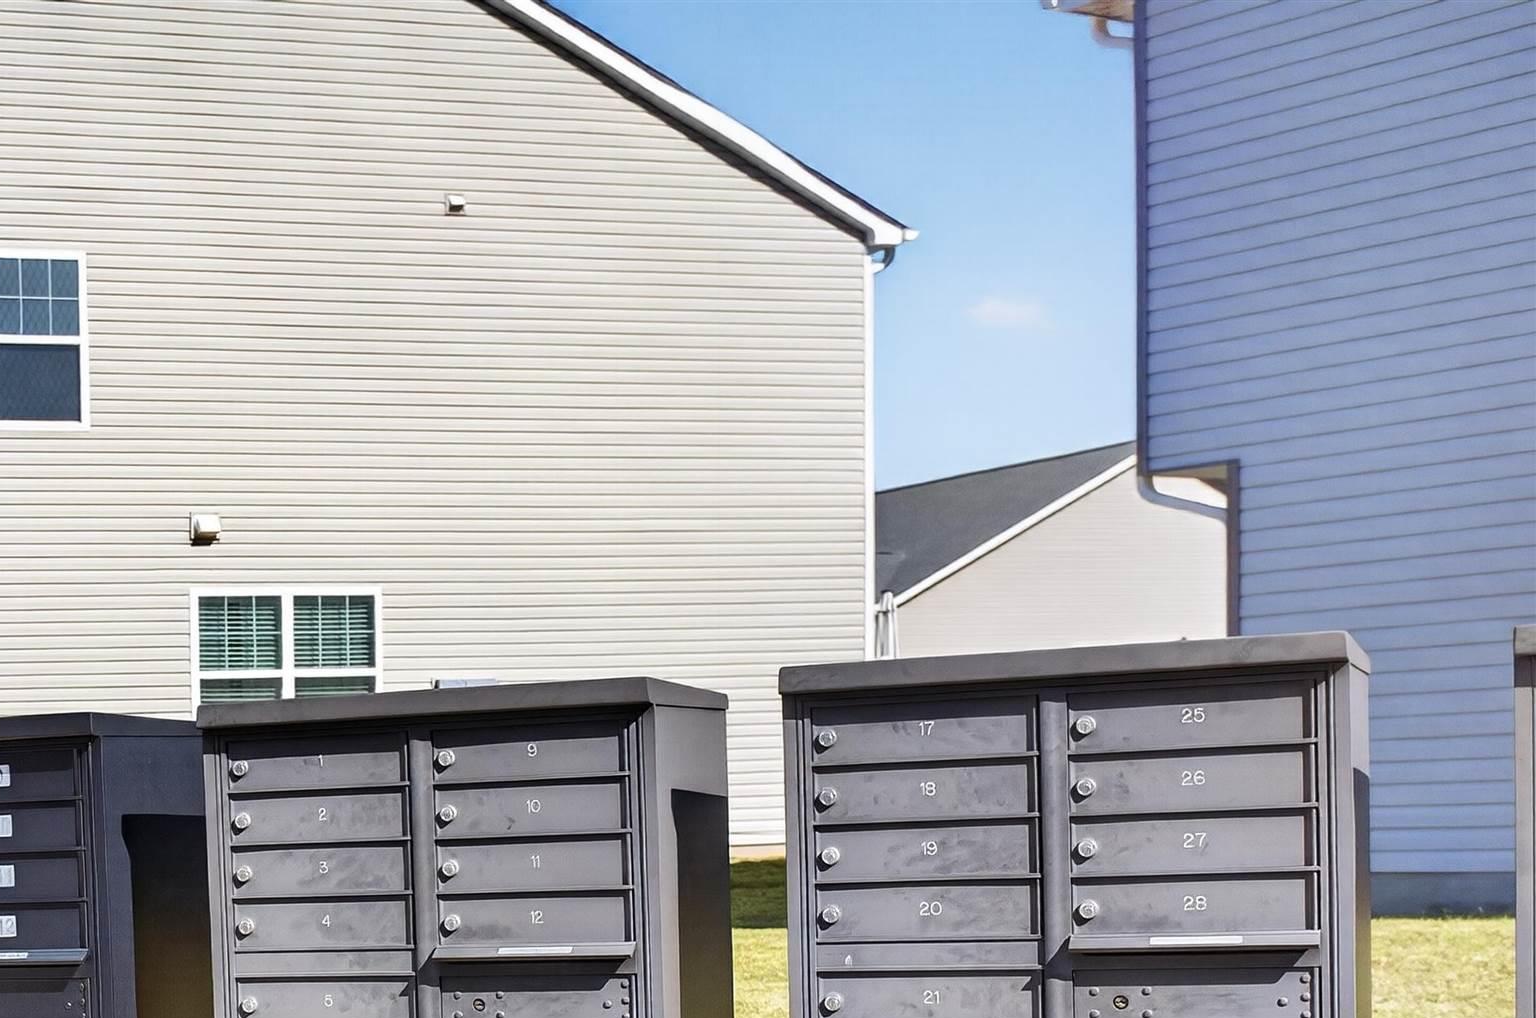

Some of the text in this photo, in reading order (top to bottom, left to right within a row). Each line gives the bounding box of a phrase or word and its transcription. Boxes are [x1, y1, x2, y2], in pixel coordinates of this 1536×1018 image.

[1181, 707, 1206, 724] 25
[918, 720, 935, 737] 17
[527, 743, 538, 757] 9
[317, 754, 324, 767] 1
[1181, 769, 1206, 786] 26
[919, 781, 936, 796] 18
[526, 799, 541, 814] 10
[318, 807, 327, 822] 2
[1183, 832, 1207, 849] 27
[920, 841, 938, 856] 19
[319, 861, 329, 874] 3
[530, 855, 541, 868] 11
[919, 901, 943, 916] 20
[1183, 895, 1207, 911] 28
[321, 914, 331, 928] 4
[530, 910, 544, 924] 12
[0, 919, 16, 935] 12
[923, 990, 940, 1005] 21
